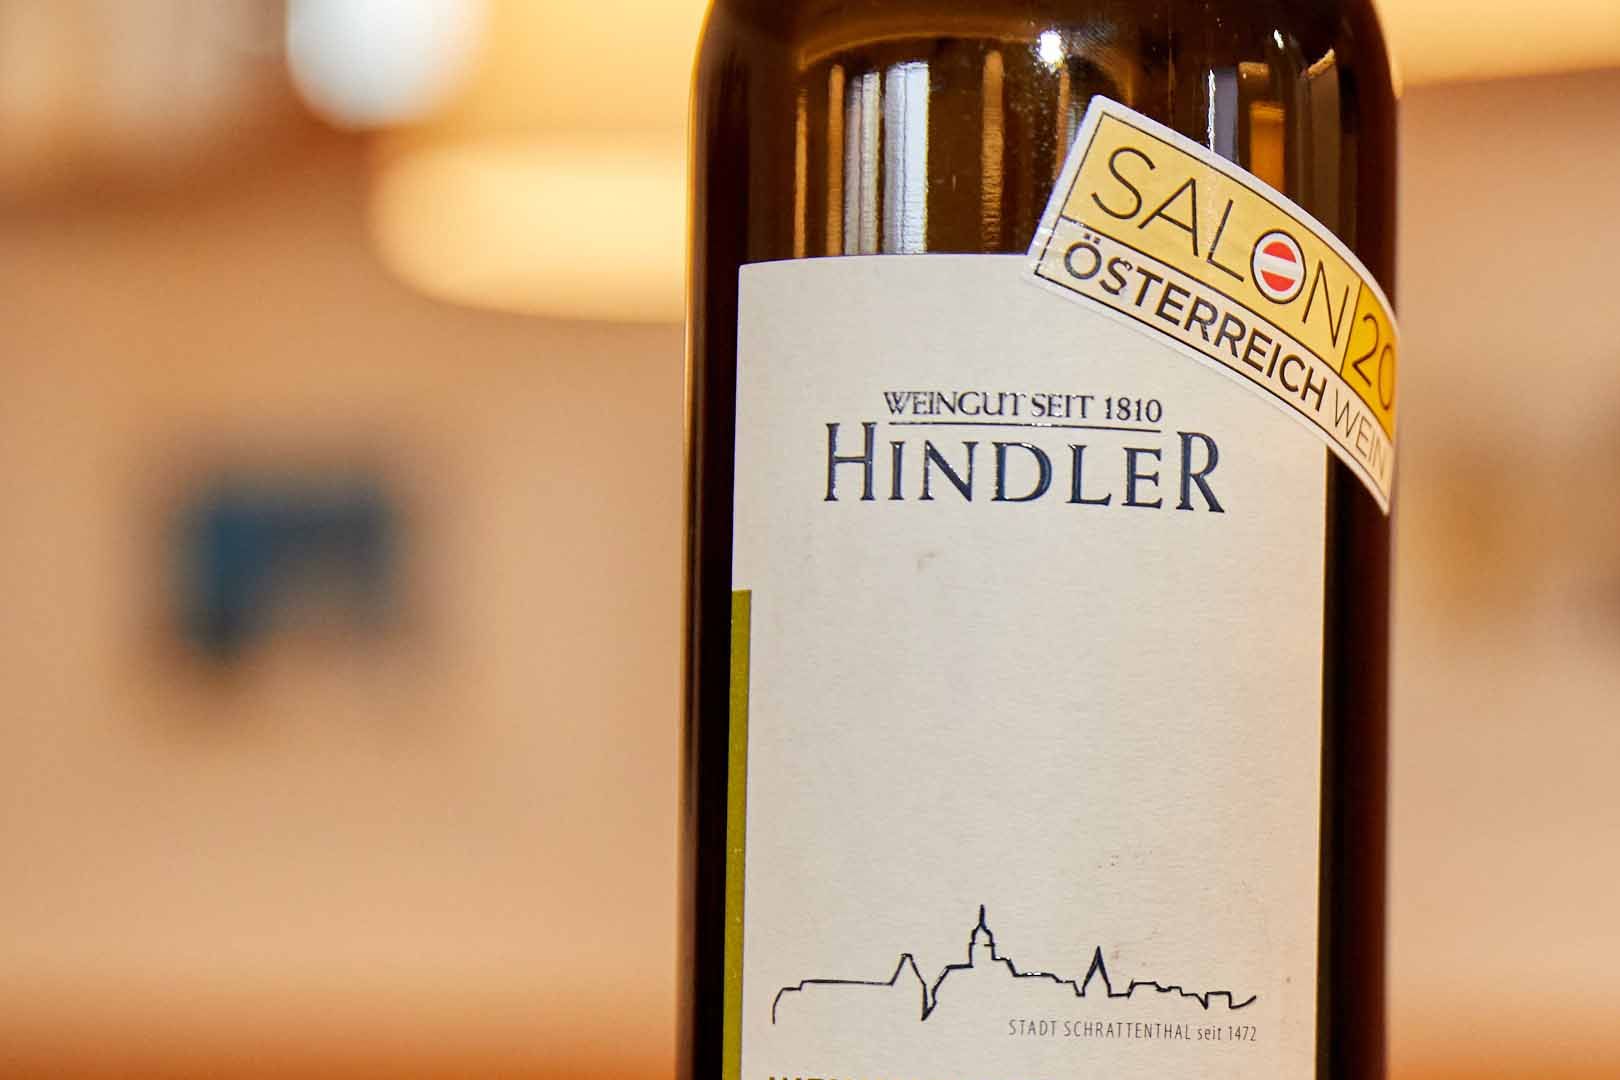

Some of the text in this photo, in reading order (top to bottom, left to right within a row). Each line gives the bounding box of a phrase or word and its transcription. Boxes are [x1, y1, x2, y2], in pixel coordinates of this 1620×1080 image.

[1091, 146, 1350, 348] SALON
[1063, 233, 1328, 412] ÖSTERREICH
[883, 391, 1163, 423] WEINGUT SEIT 1810
[823, 421, 1225, 513] HINDLER
[1008, 1019, 1257, 1042] STADT SCHRATTENTHAL seit 1472
